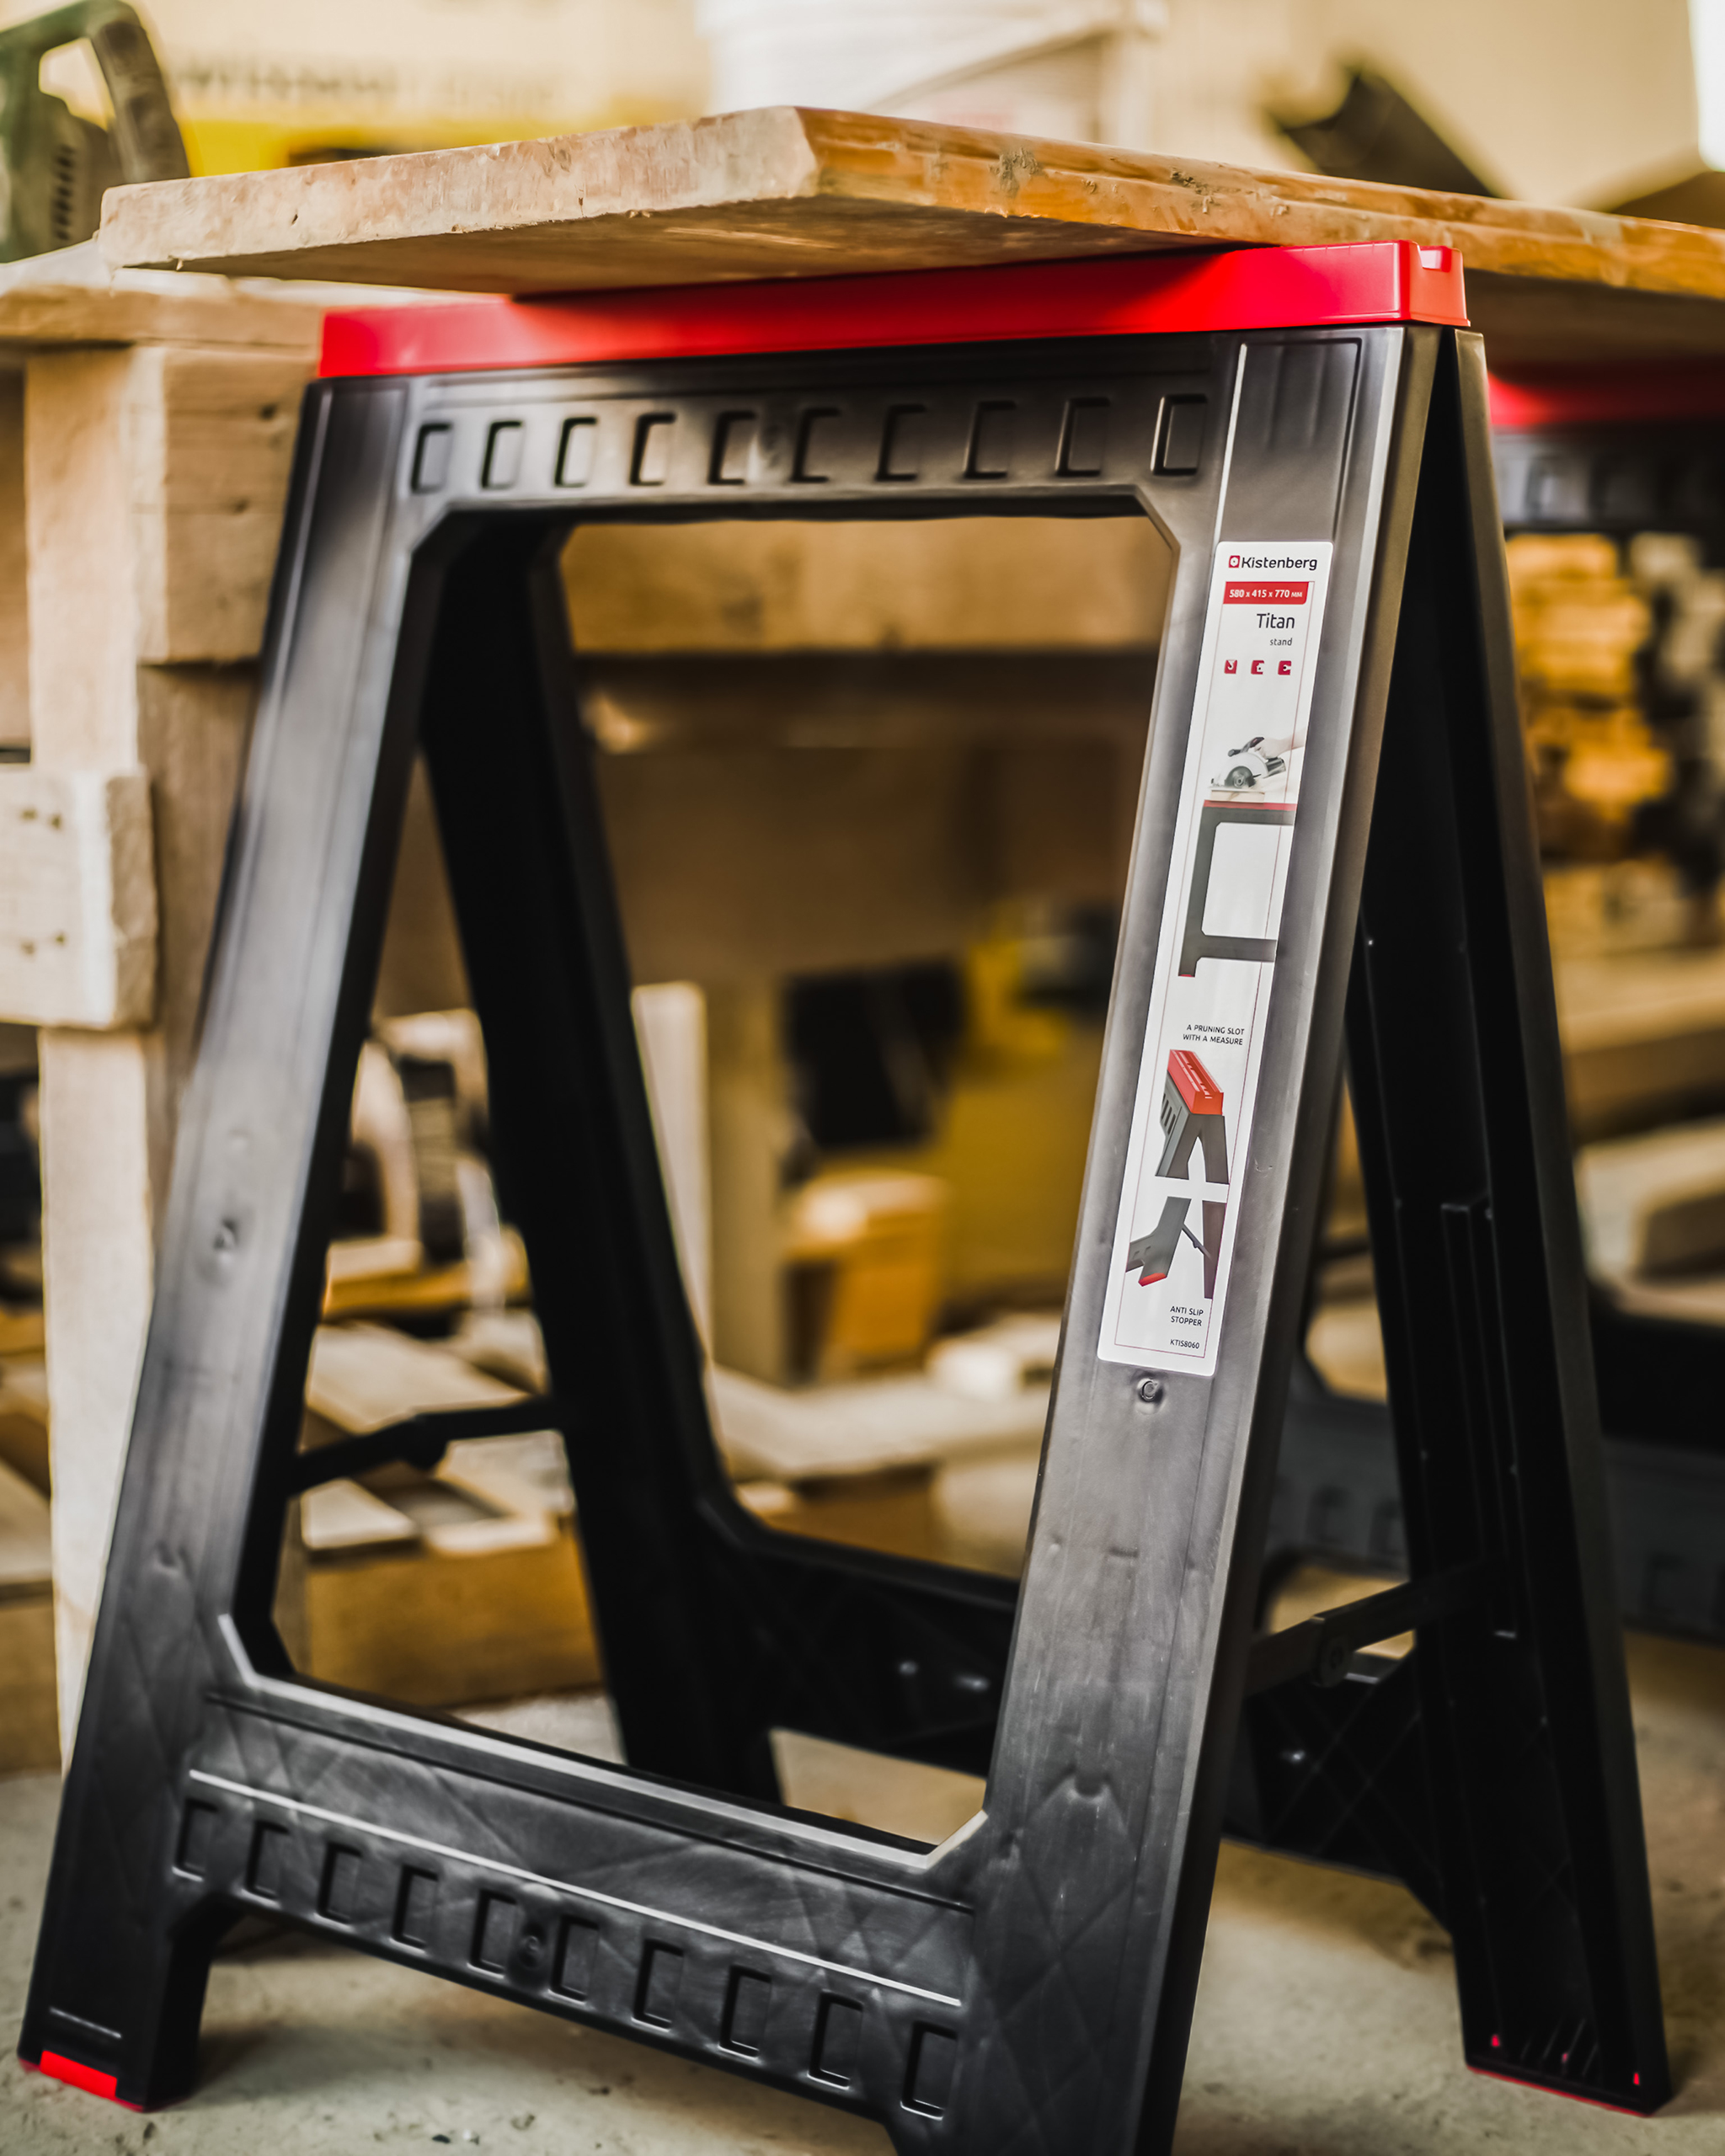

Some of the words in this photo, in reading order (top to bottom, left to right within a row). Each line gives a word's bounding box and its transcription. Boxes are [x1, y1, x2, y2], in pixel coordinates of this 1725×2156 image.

[1241, 557, 1318, 571] Kistenberg
[1229, 589, 1245, 598] 580
[1251, 589, 1267, 598] 415
[1274, 589, 1290, 598] 770
[1256, 612, 1295, 629] Titan
[1269, 637, 1293, 646] stand
[1194, 1024, 1226, 1034] PRUNING
[1210, 1036, 1243, 1045] MEASURE
[1170, 1305, 1187, 1314] ANTI
[1188, 1308, 1204, 1316] SLIP
[1171, 1315, 1202, 1326] STOPPER
[1170, 1338, 1200, 1349] KTIS8060
